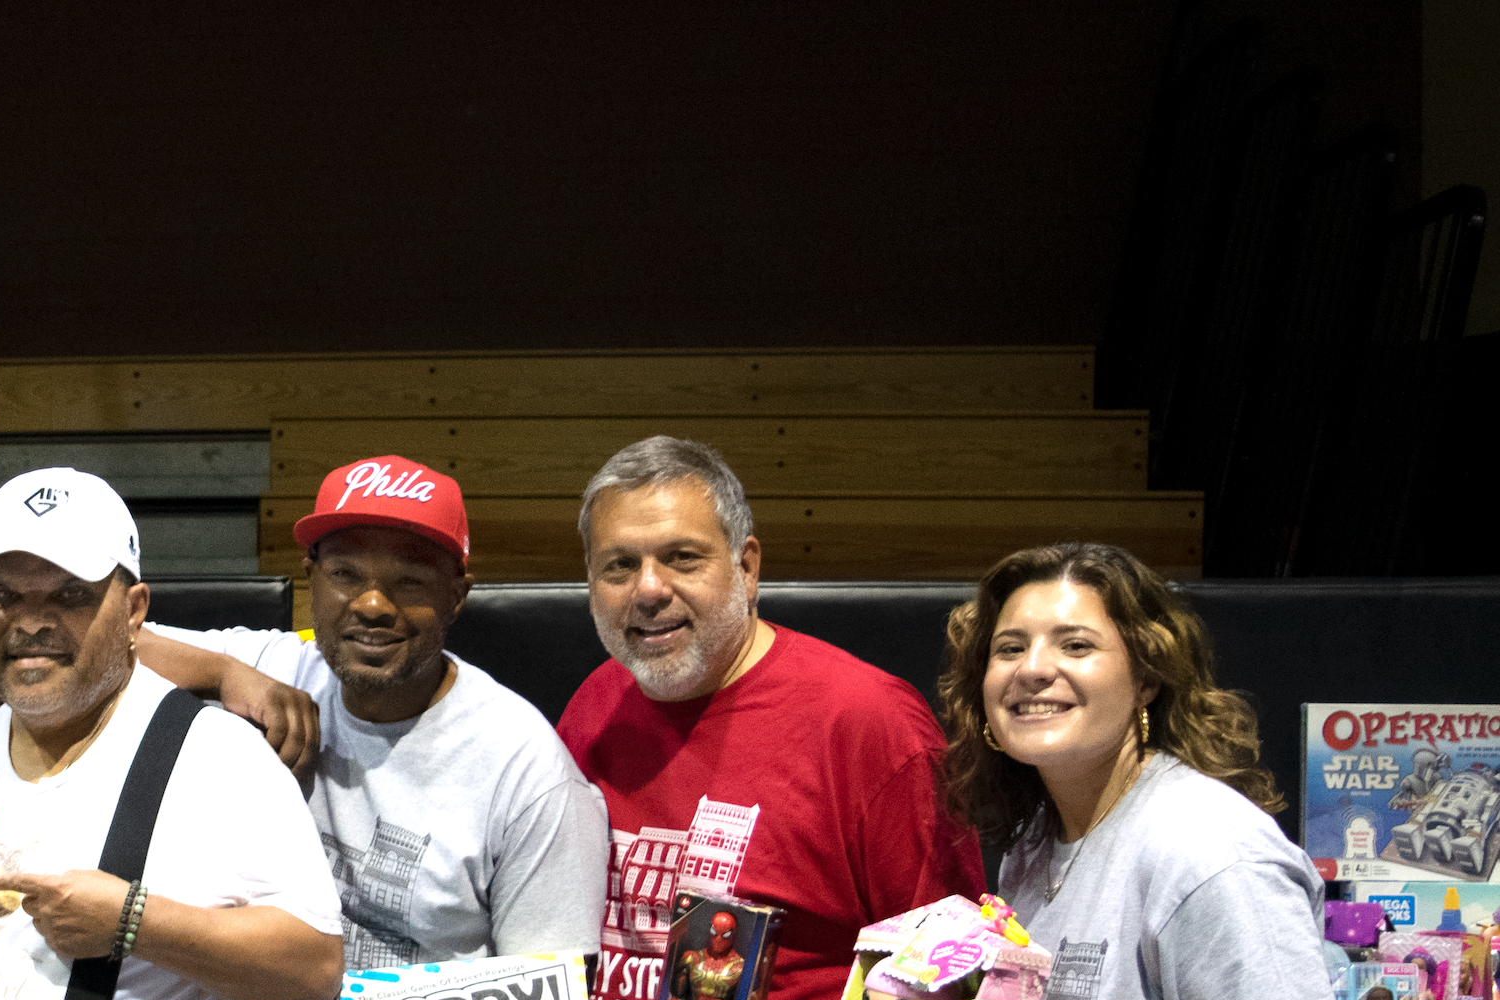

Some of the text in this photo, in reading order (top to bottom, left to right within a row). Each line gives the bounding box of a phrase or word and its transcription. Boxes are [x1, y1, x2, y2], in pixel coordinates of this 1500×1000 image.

[336, 462, 436, 511] Phila
[1323, 755, 1399, 771] STAR
[1324, 773, 1399, 789] WARS
[1390, 911, 1411, 922] OKS
[377, 988, 407, 999] Classic
[410, 982, 437, 993] Game
[454, 972, 482, 983] Sweet
[485, 964, 525, 978] Revenge
